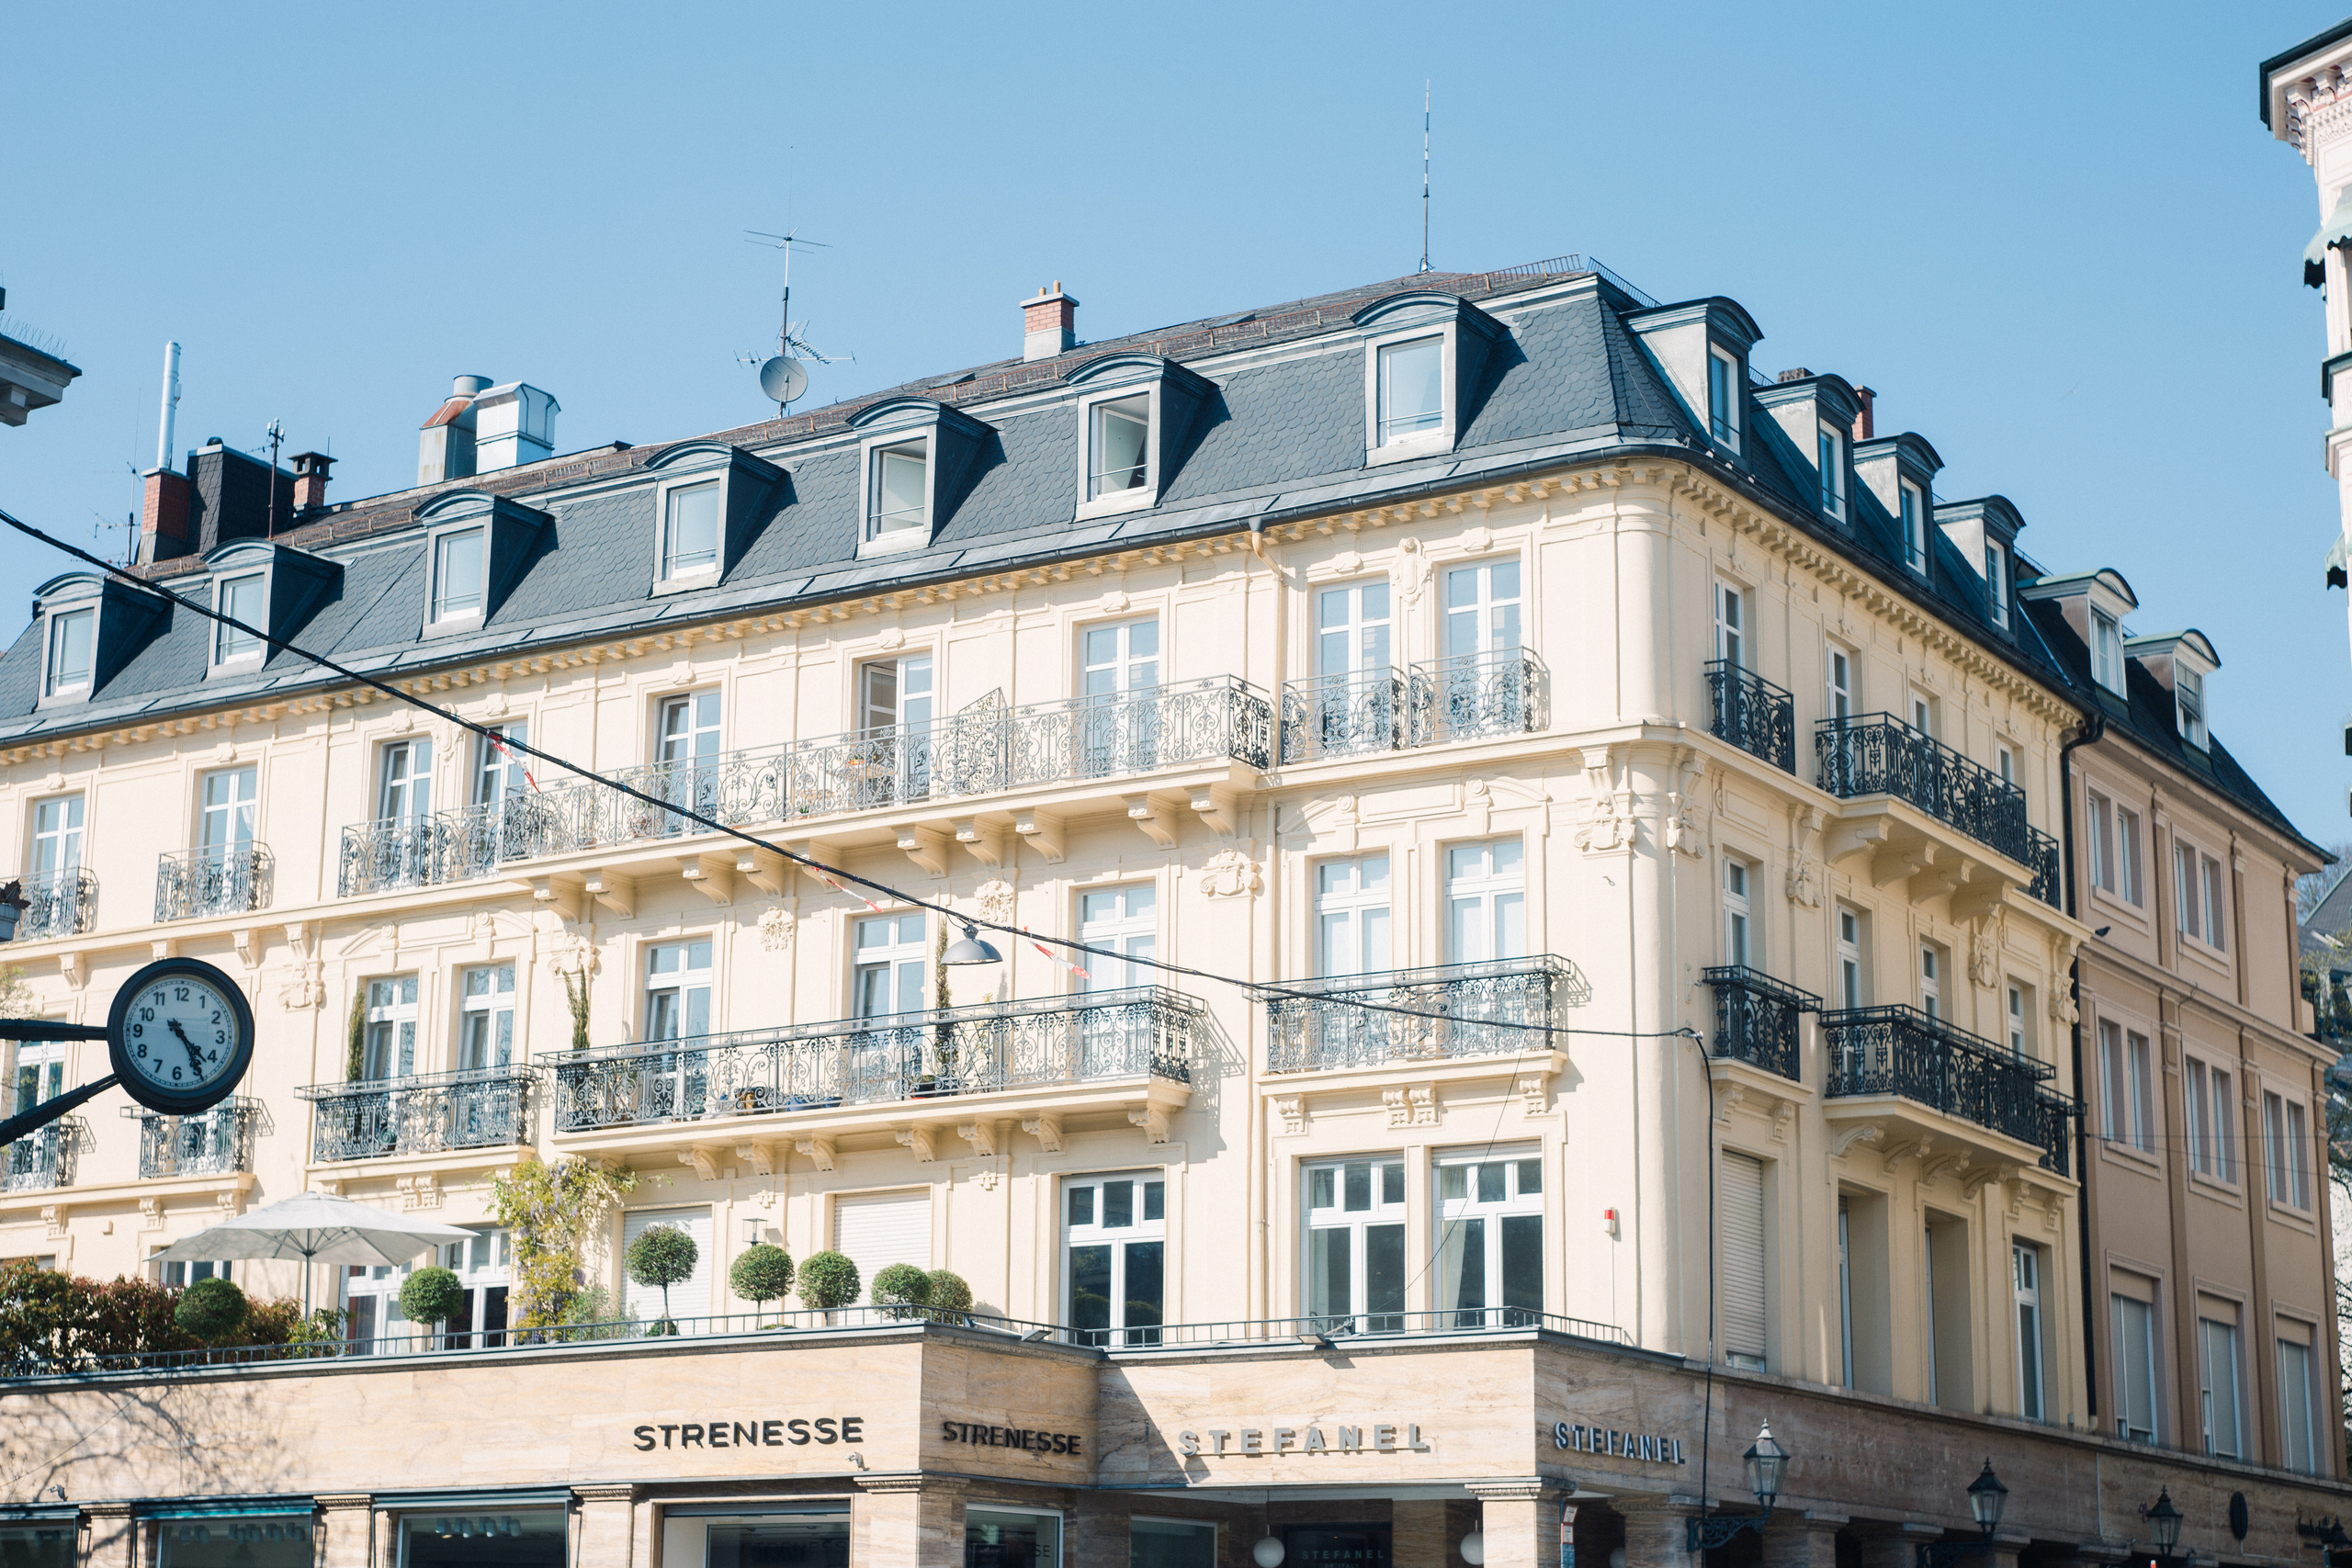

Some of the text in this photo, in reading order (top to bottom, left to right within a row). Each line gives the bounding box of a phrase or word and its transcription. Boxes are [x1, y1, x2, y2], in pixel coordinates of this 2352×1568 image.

[153, 992, 165, 1006] 11
[175, 987, 190, 1001] 12
[199, 995, 206, 1009] 1
[140, 1007, 154, 1021] 10
[211, 1010, 220, 1024] 2
[133, 1024, 143, 1038] 9
[215, 1030, 225, 1044] 3
[137, 1043, 148, 1058] 8
[207, 1049, 218, 1064] 4
[153, 1059, 163, 1073] 7
[172, 1066, 182, 1080] 6
[634, 1416, 864, 1451] STRENESSE
[943, 1421, 1081, 1455] STRENESSE
[1177, 1423, 1429, 1456] STEFANEL
[1555, 1422, 1686, 1464] STEFANEL
[1301, 1550, 1385, 1560] STEFANEL
